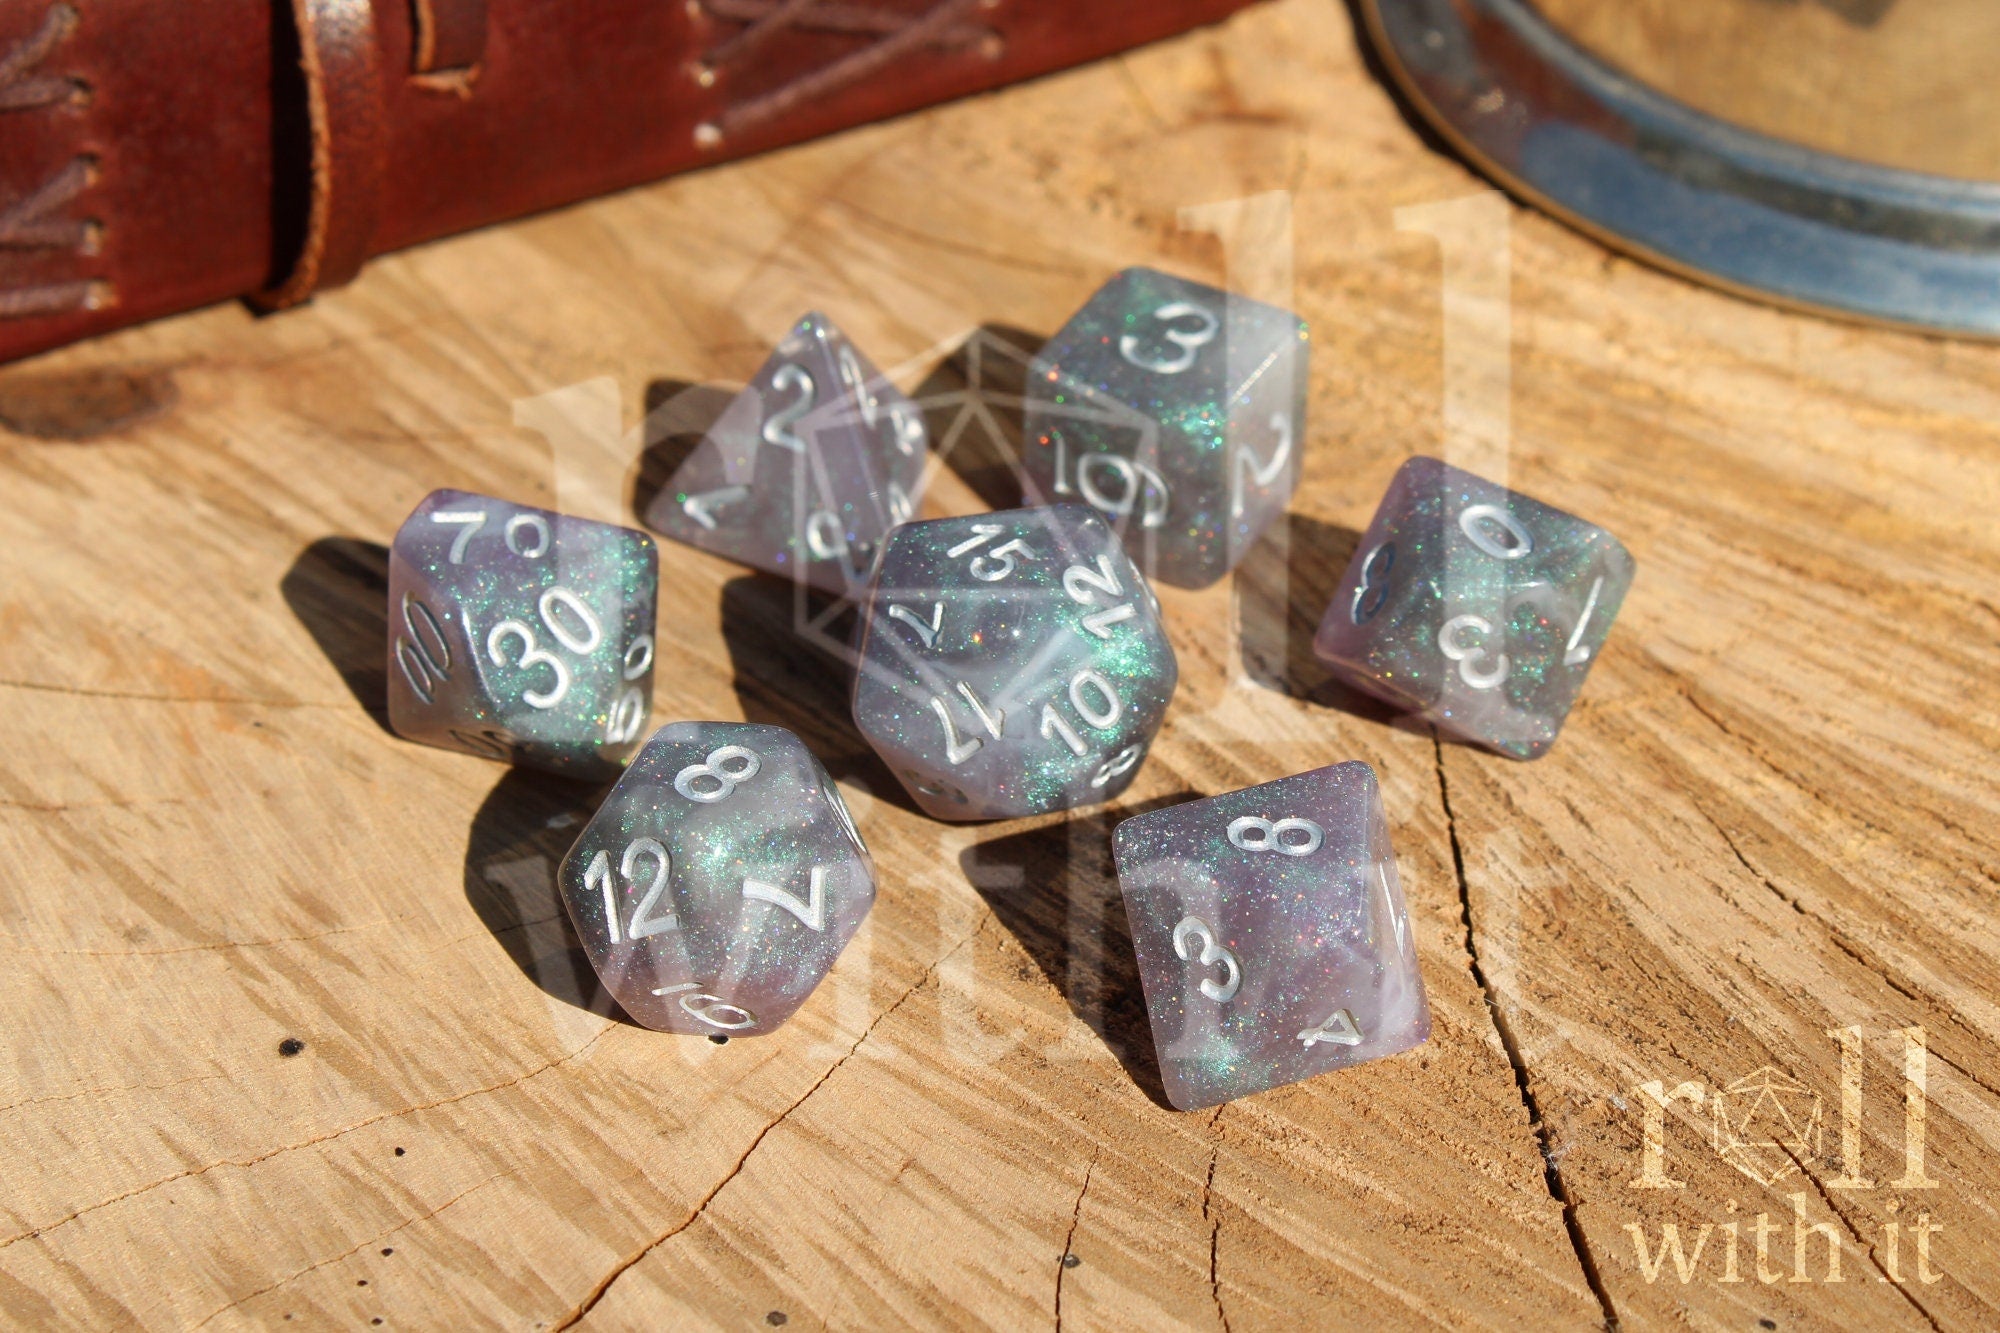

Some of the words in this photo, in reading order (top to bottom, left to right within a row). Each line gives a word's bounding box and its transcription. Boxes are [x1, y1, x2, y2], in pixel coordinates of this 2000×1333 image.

[1119, 302, 1219, 374] 3
[763, 364, 815, 452] 2
[430, 511, 549, 565] 70
[947, 524, 1036, 582] 15
[1458, 504, 1534, 560] 0
[1062, 554, 1137, 640] 12
[487, 586, 601, 709] 30
[1438, 614, 1510, 688] 3
[930, 680, 1006, 765] 17
[1040, 669, 1124, 756] 10
[674, 745, 762, 803] 8
[1227, 815, 1326, 857] 8
[583, 836, 680, 945] 12
[742, 864, 828, 931] 7
[1172, 916, 1242, 1003] 3
[1296, 1008, 1364, 1047] 4
